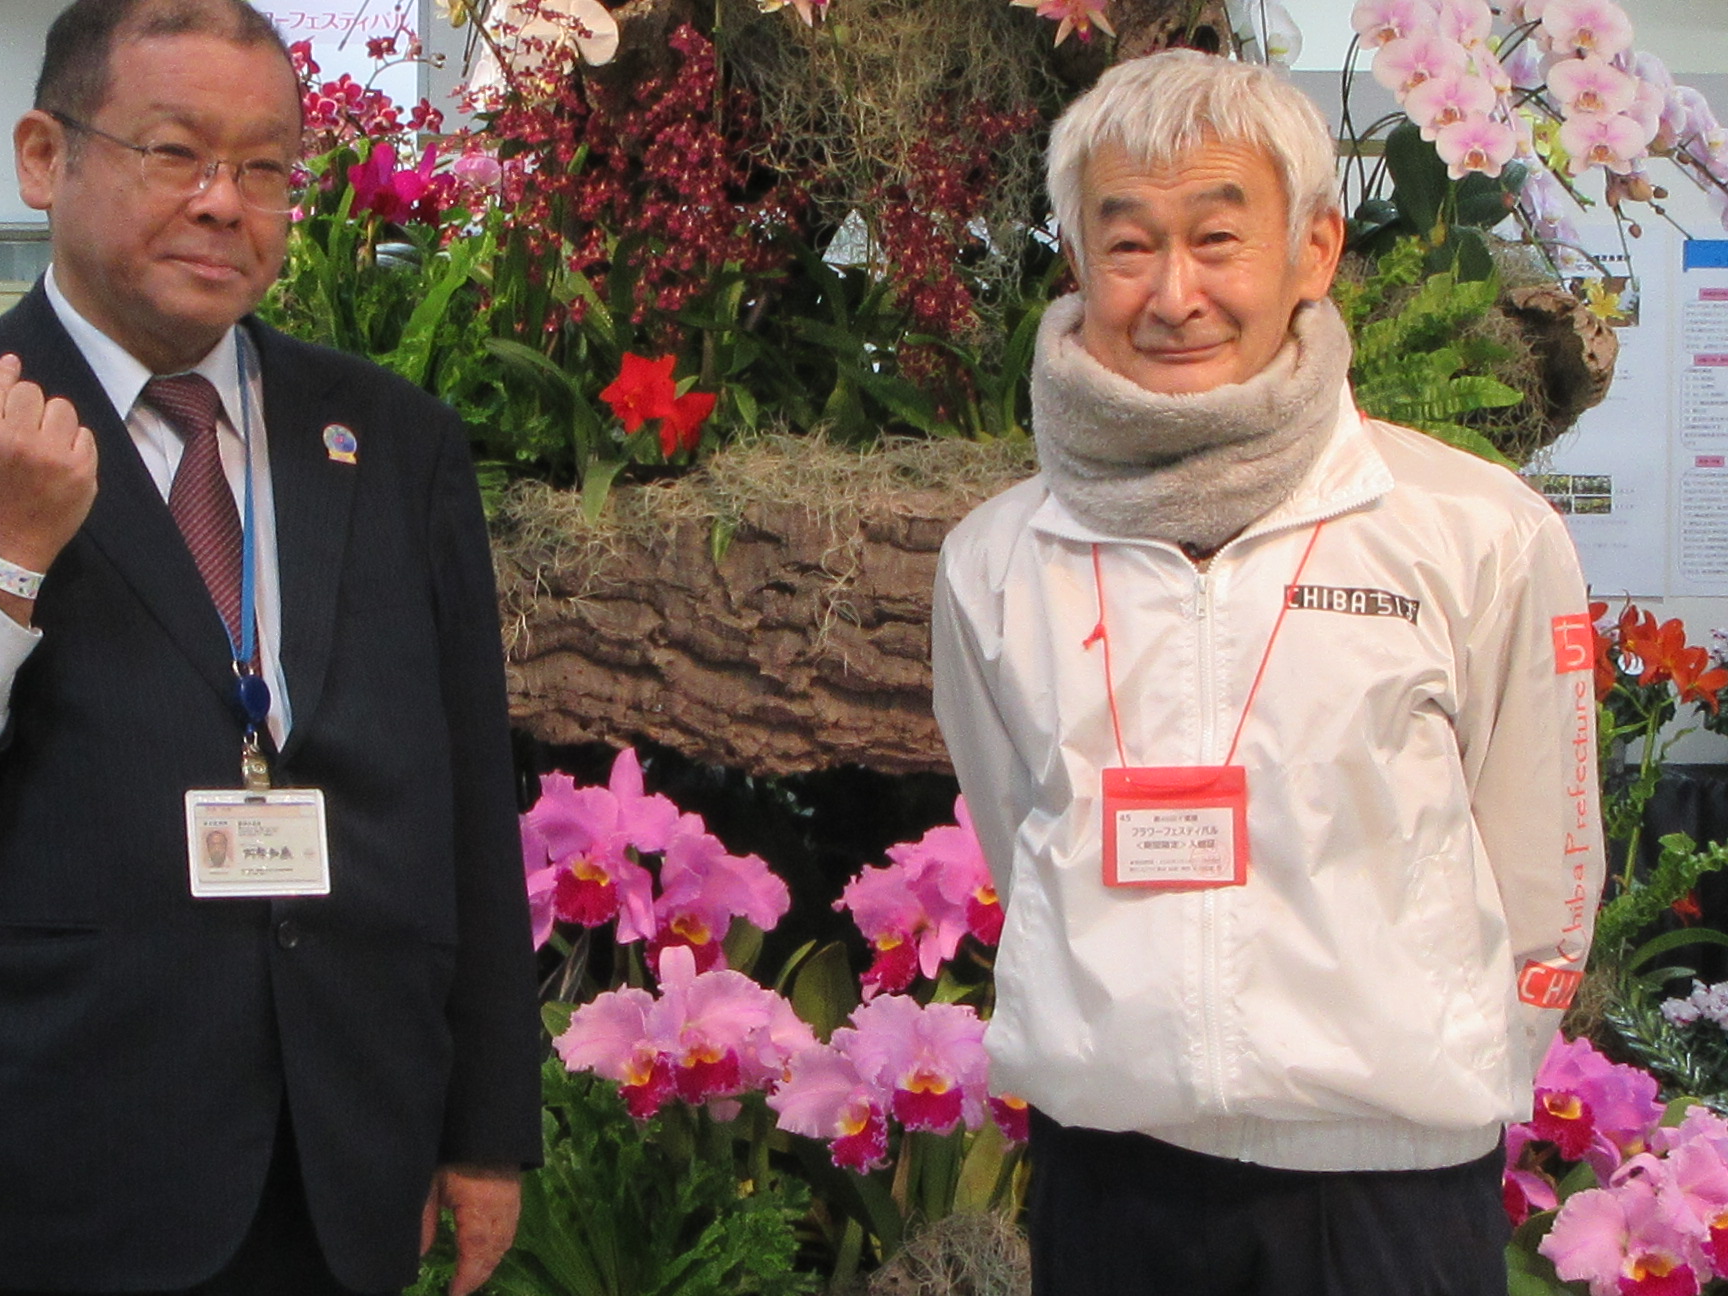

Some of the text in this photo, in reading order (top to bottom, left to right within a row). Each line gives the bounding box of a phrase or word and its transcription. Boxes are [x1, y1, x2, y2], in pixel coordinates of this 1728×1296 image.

[266, 11, 410, 32] ーフェスティバル
[1564, 679, 1591, 856] Prefecture
